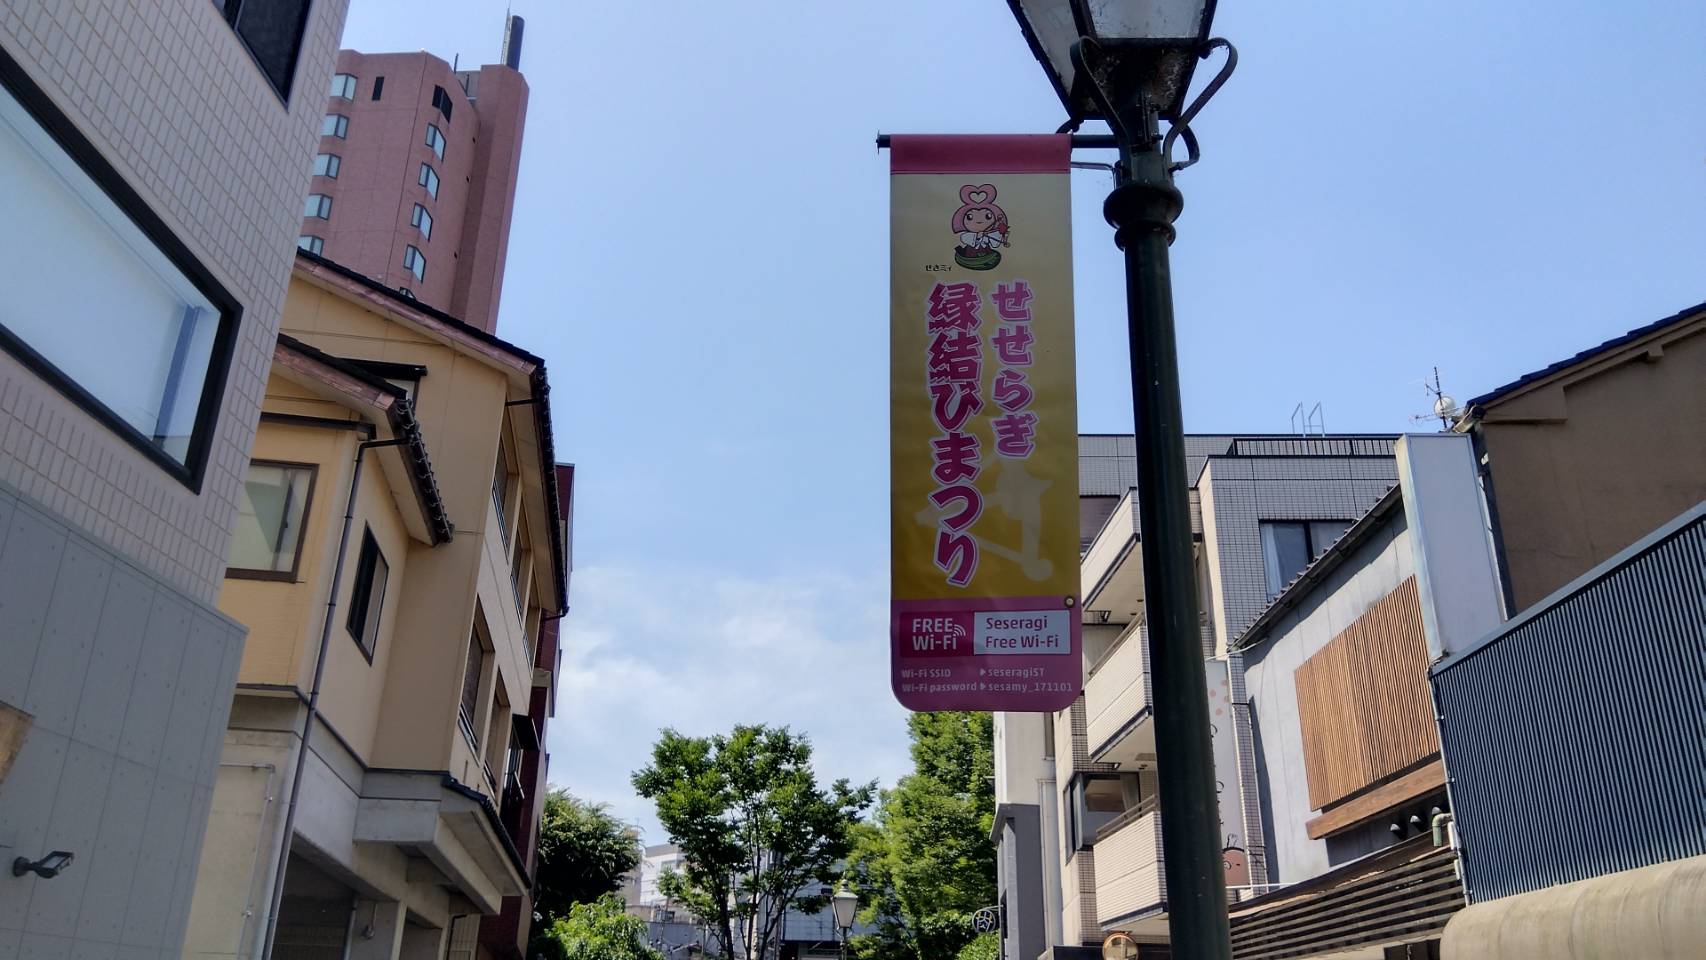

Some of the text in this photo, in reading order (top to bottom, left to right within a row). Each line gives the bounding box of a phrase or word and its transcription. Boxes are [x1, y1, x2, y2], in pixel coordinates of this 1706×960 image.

[992, 281, 1037, 458] せせらぎ
[928, 281, 984, 587] 縁結びまつり
[912, 618, 954, 633] FREE
[986, 617, 1048, 631] Seseragi
[912, 634, 957, 651] Wi-Fi
[985, 634, 1059, 649] Free Wi-Fi
[901, 666, 1045, 679] Wi-Fi SSID seseragiST
[901, 682, 1073, 693] Wi-Fi password sesamy_171101
